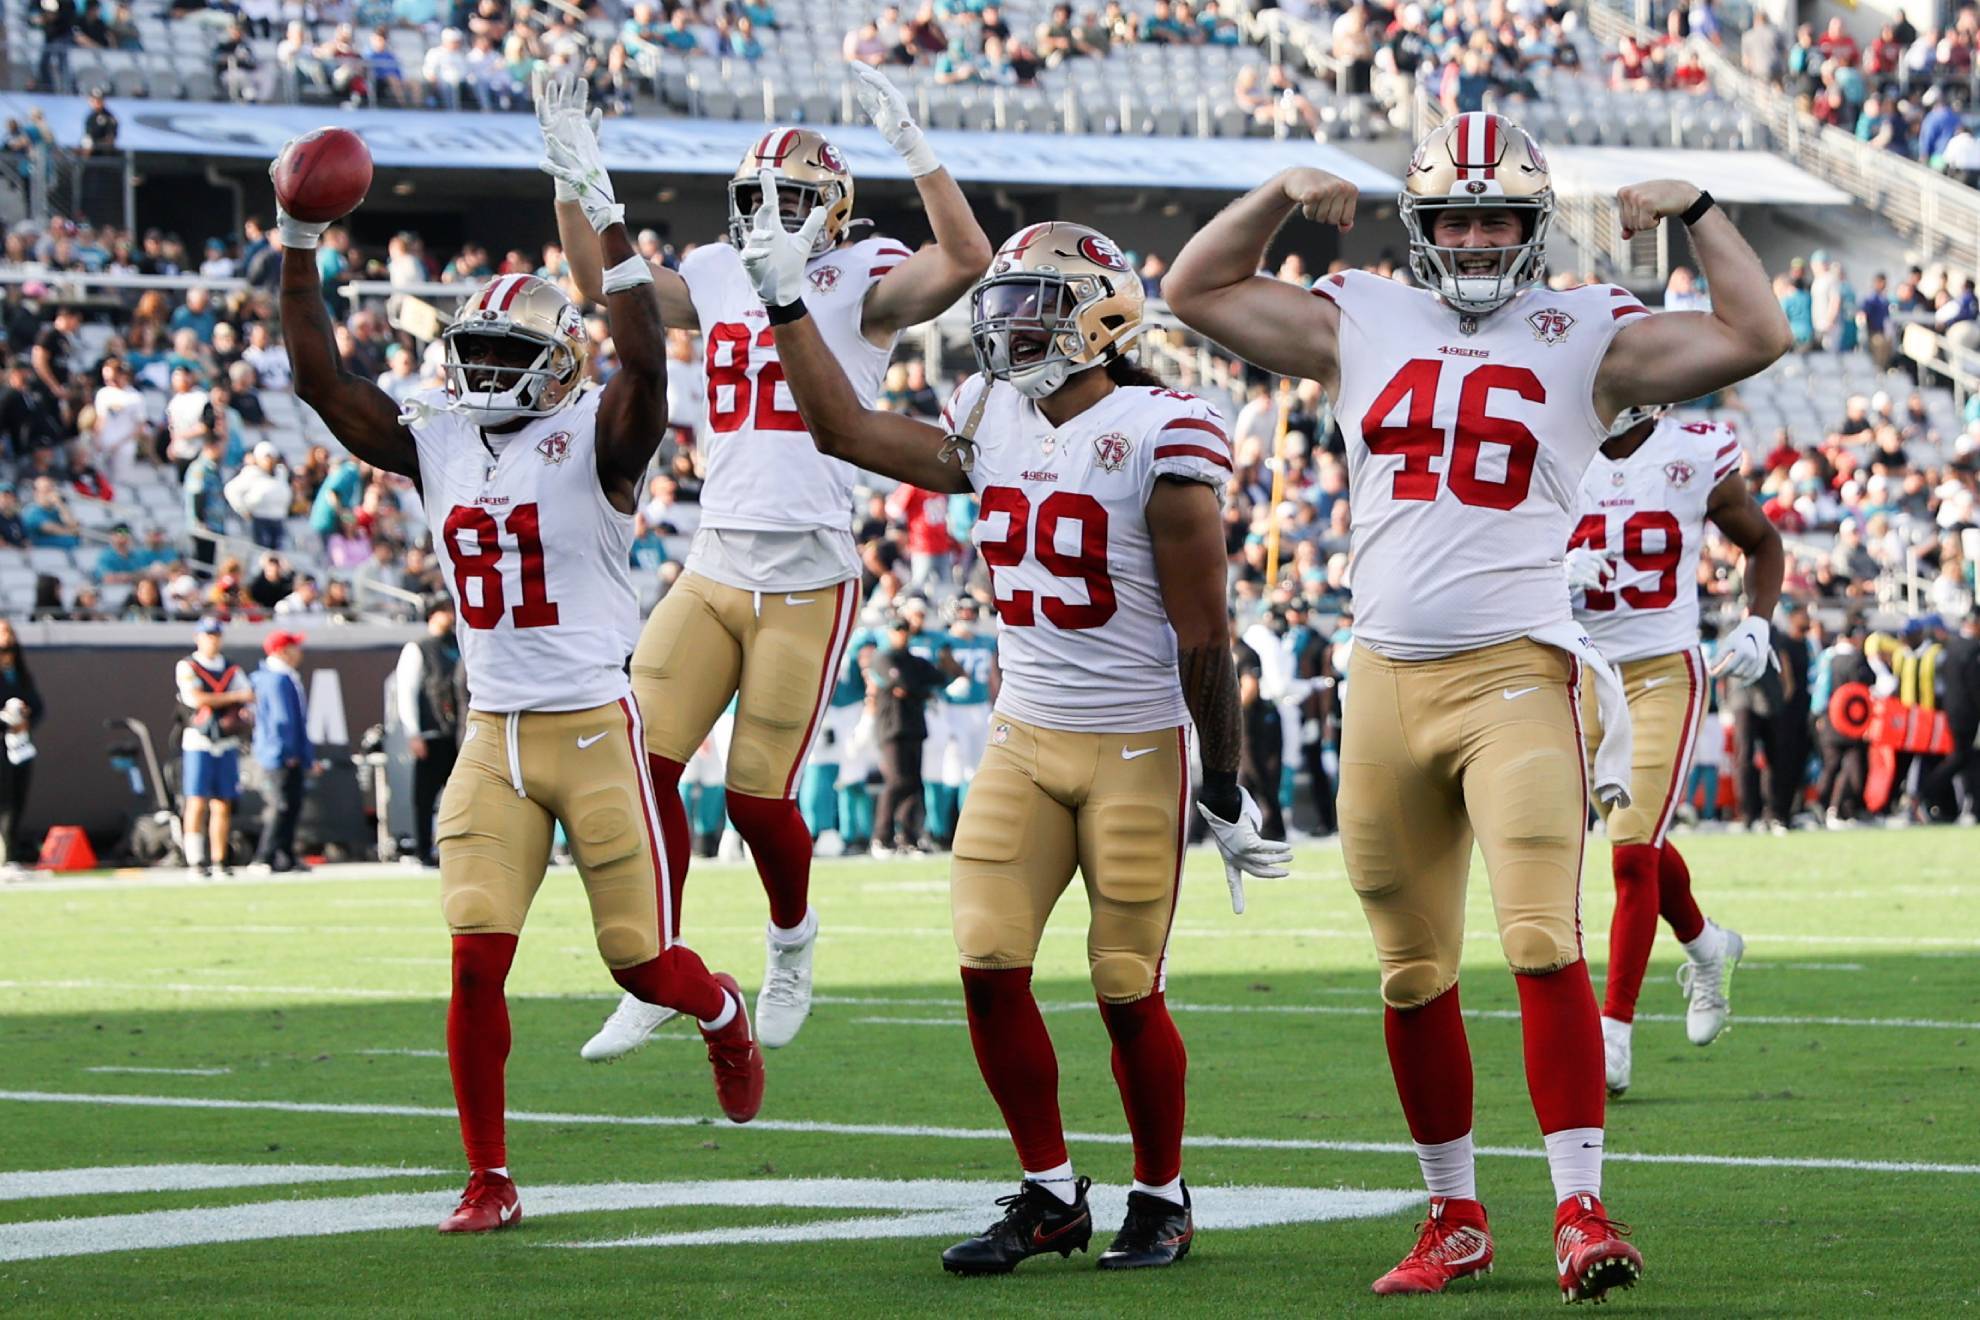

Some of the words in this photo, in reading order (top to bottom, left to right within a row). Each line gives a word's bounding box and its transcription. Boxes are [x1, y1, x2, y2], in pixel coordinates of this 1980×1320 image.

[1437, 345, 1491, 359] 49ERS
[1538, 315, 1567, 335] 75
[706, 321, 808, 434] 82
[1020, 470, 1059, 483] 49ERS
[1101, 438, 1126, 464] 75
[1361, 358, 1546, 511] 46
[443, 503, 560, 630] 81
[978, 485, 1117, 630] 29
[1566, 510, 1683, 611] 49
